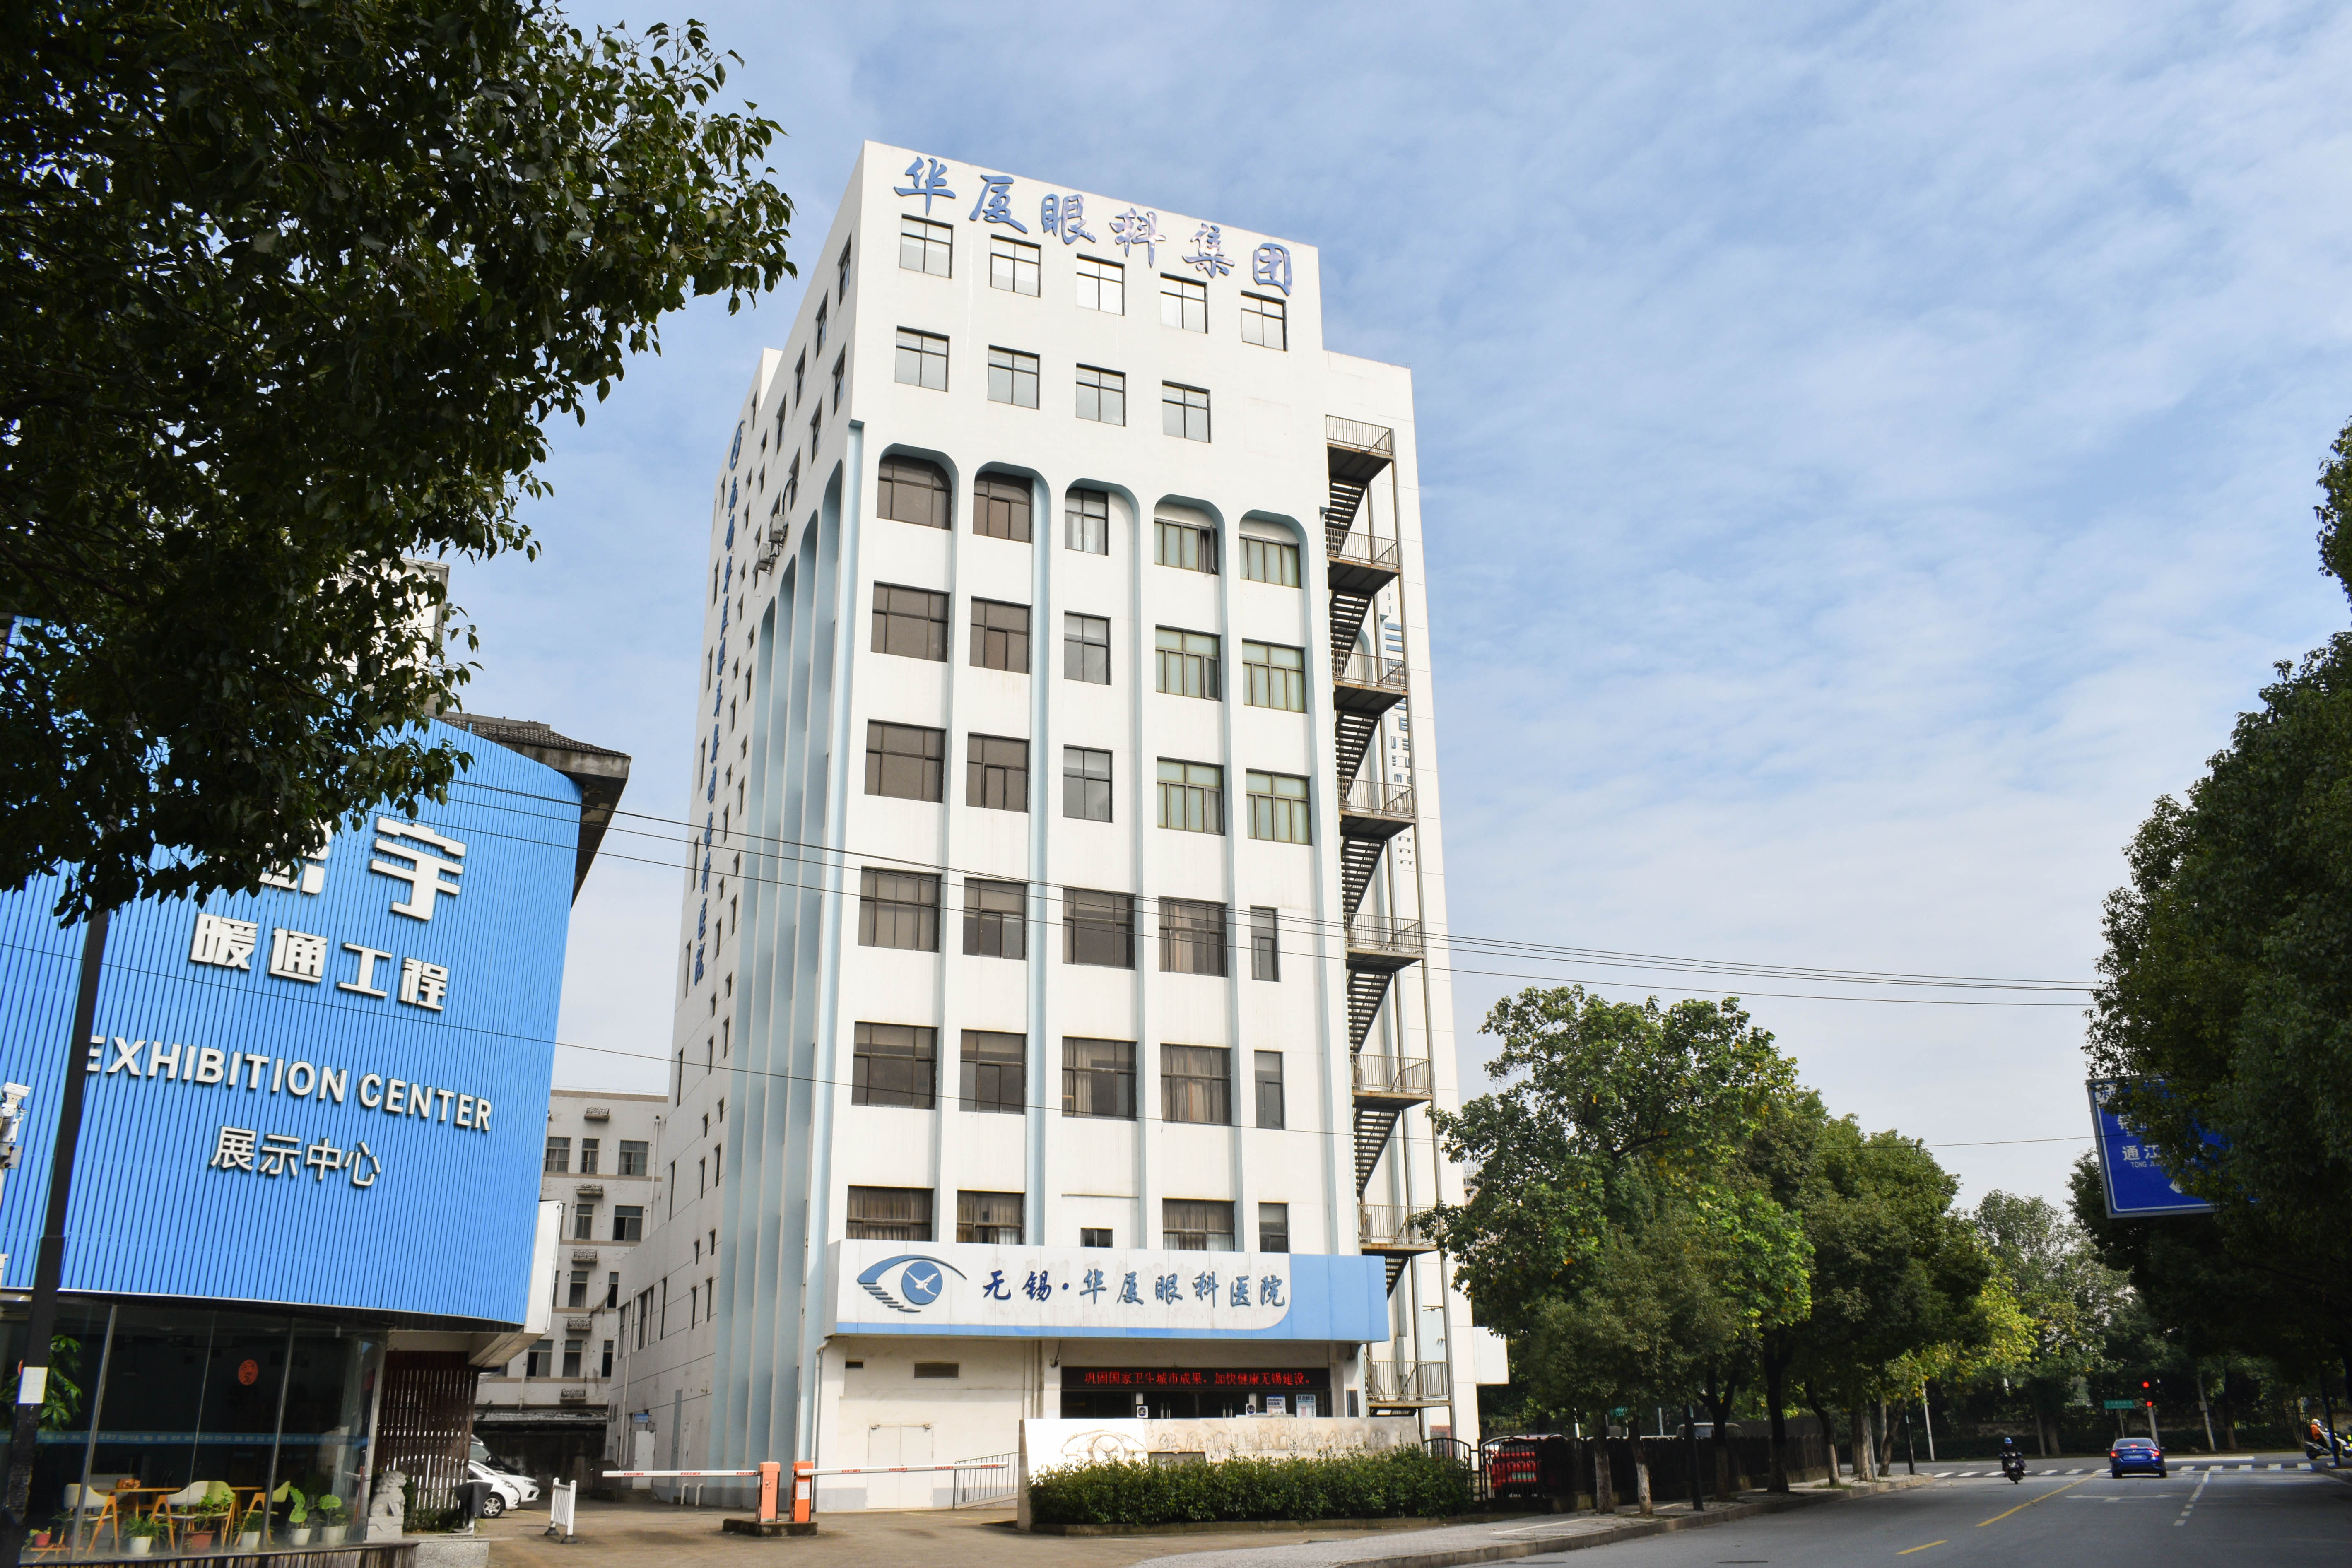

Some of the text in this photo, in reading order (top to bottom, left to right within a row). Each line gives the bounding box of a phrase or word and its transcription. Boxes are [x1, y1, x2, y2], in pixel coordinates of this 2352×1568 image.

[894, 157, 1292, 296] 华厦眼科集团
[189, 913, 449, 1011] 暖通工程
[87, 1035, 492, 1131] EXHIBITION CENTER
[211, 1126, 381, 1187] 展示中心
